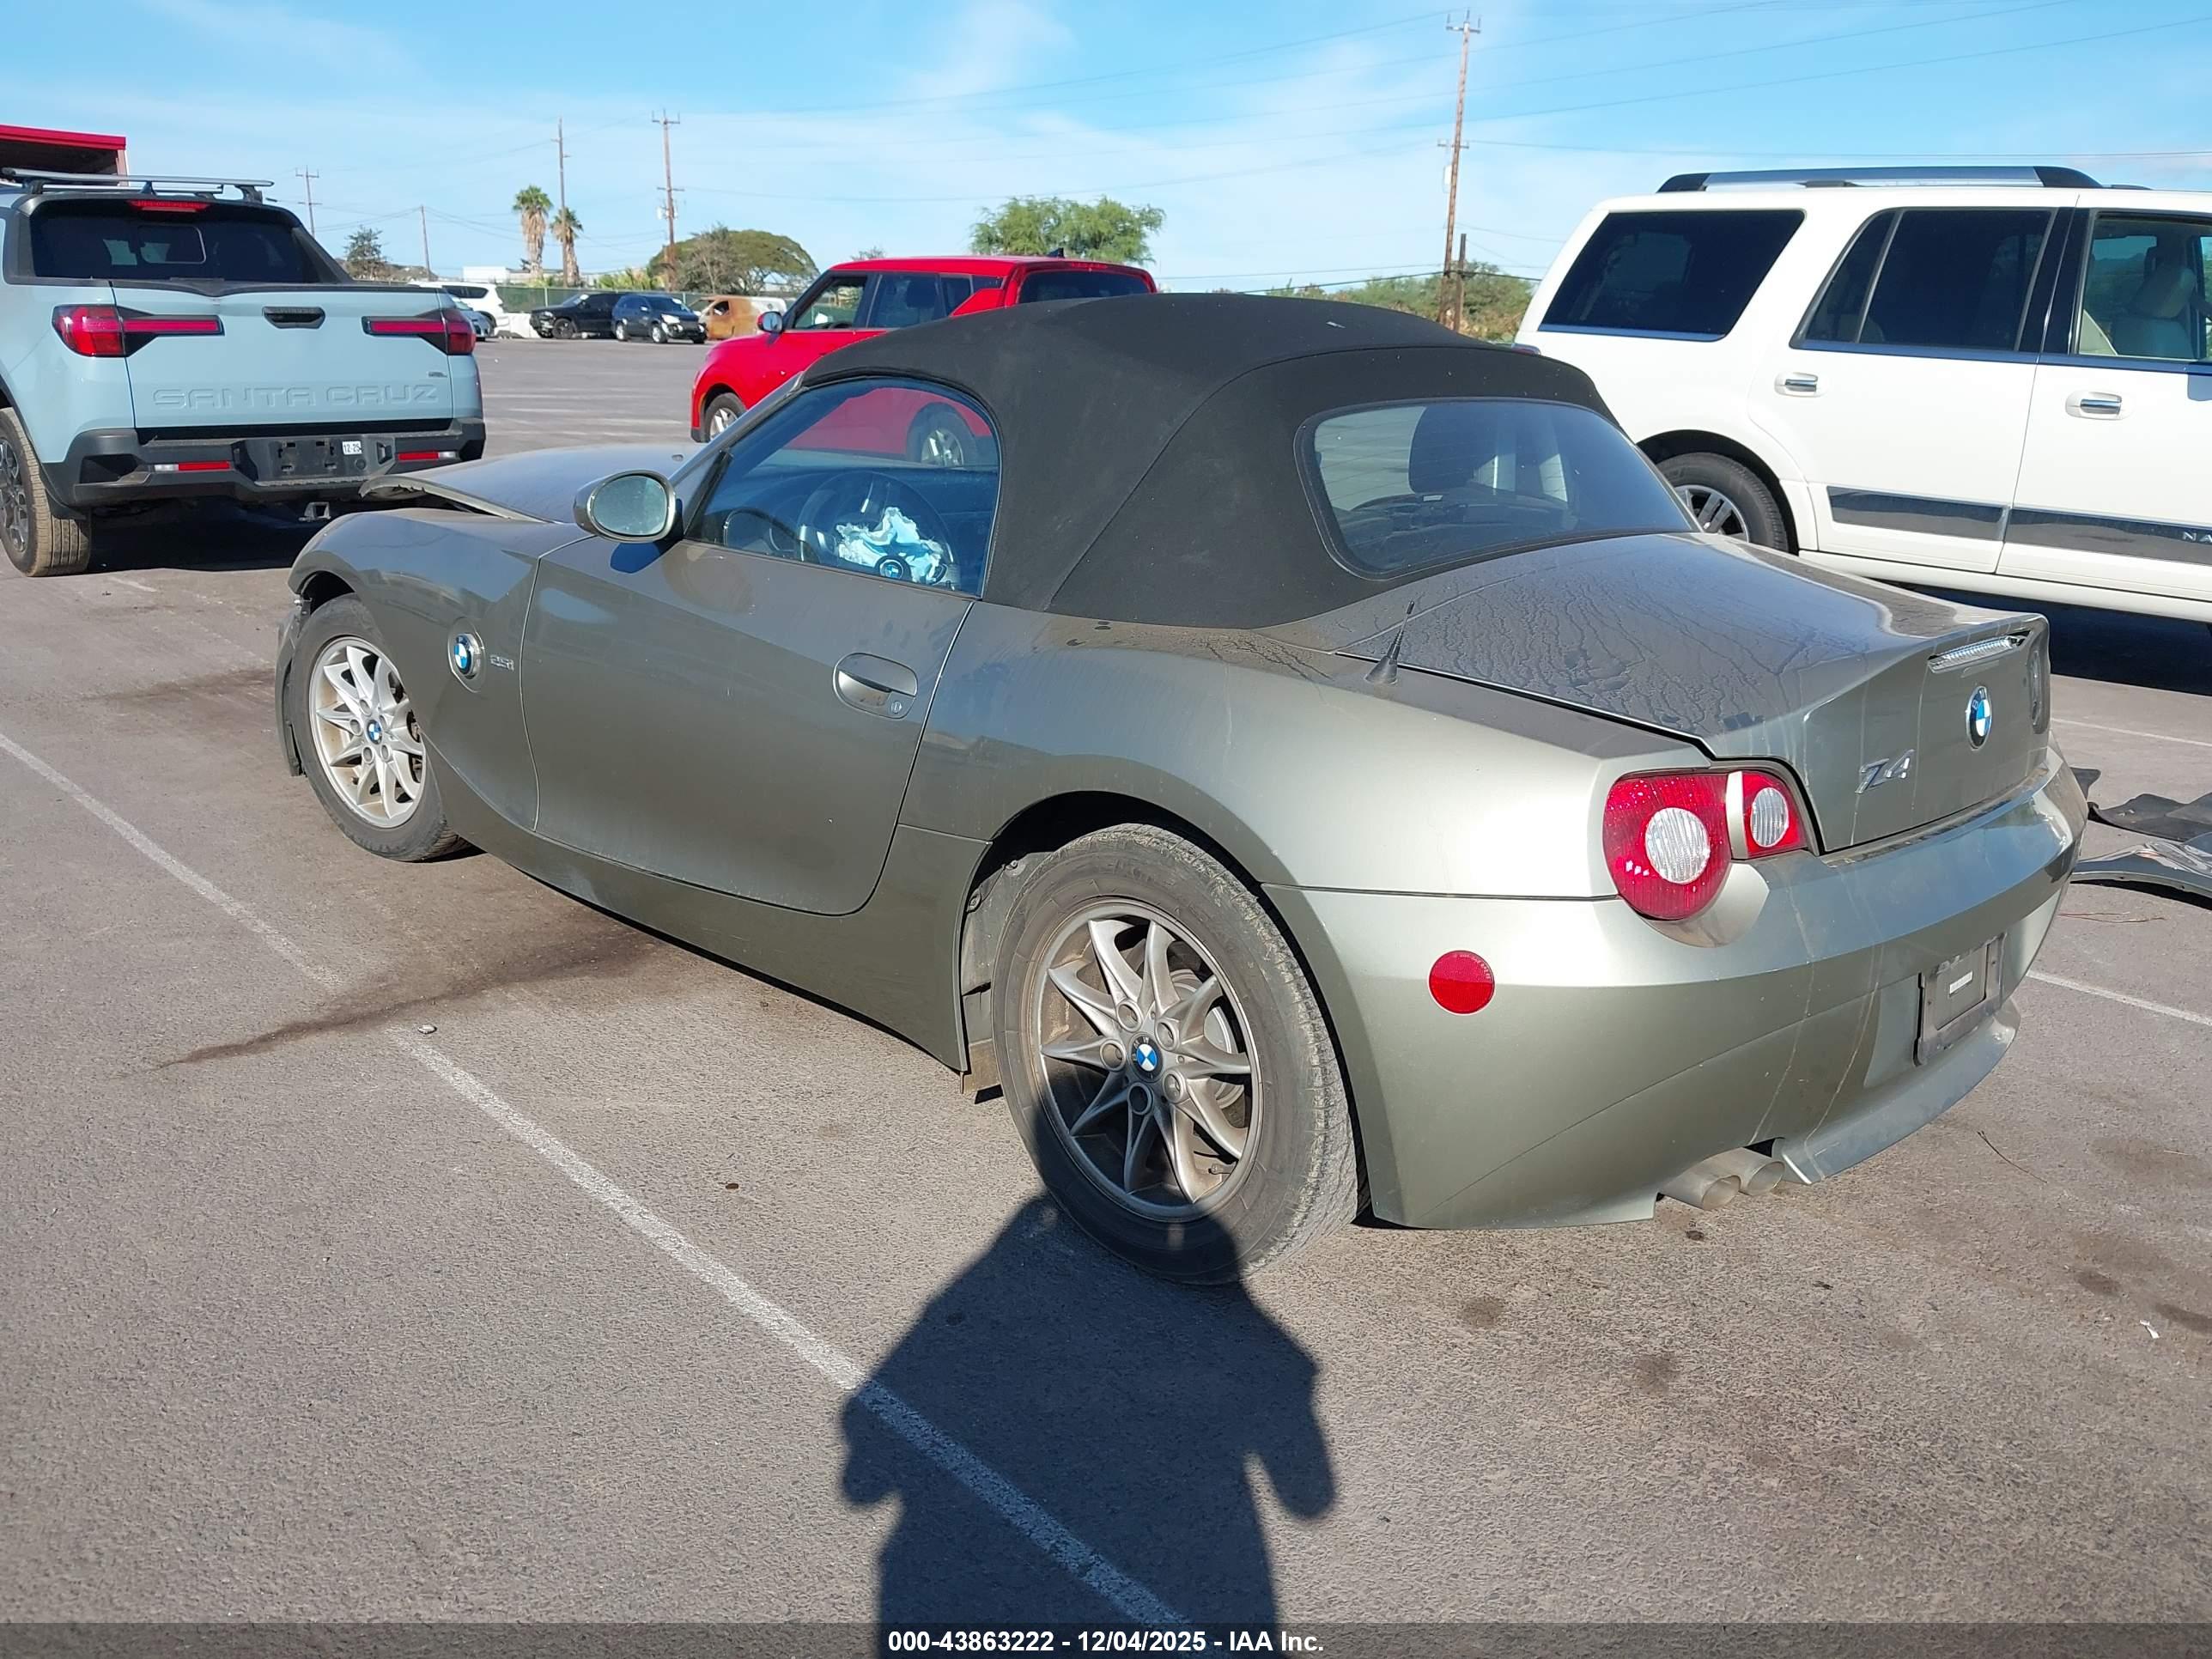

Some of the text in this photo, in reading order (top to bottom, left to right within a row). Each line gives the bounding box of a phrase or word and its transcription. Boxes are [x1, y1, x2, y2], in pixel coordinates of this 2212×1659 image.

[154, 385, 439, 410] SANTA CRUZ
[1855, 749, 1915, 793] Z4
